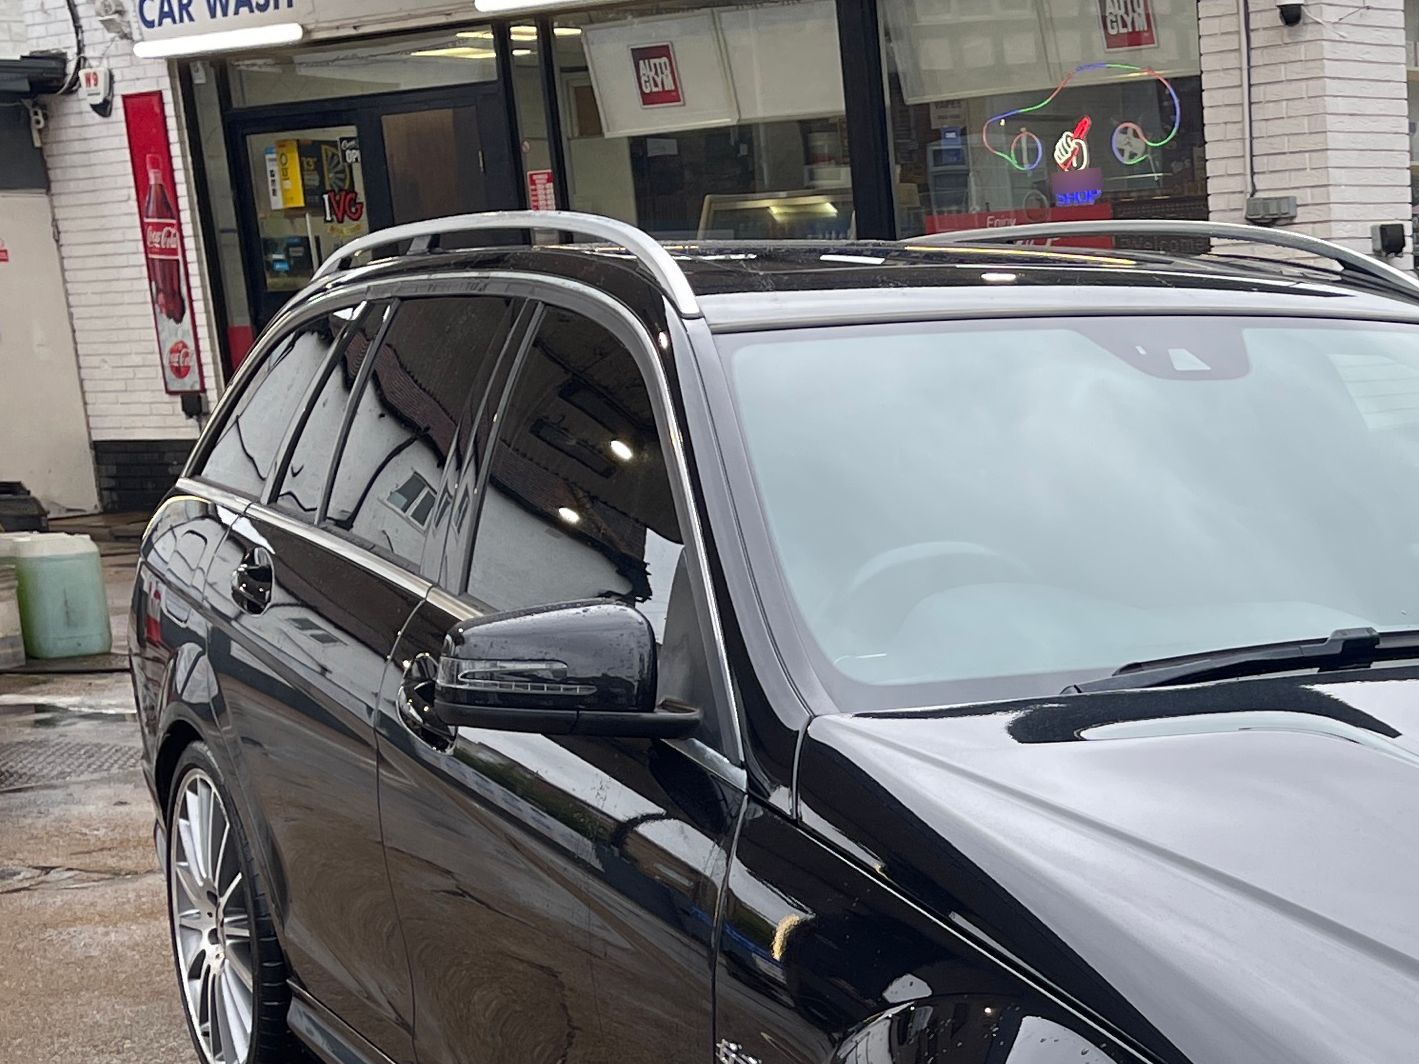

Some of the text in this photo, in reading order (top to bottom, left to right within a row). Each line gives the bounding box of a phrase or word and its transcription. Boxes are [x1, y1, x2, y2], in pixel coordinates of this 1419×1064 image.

[138, 0, 293, 29] CAR WA
[1106, 12, 1148, 35] GLYM
[639, 57, 670, 76] AUTO
[641, 71, 676, 93] GLYM
[322, 189, 364, 224] IVG
